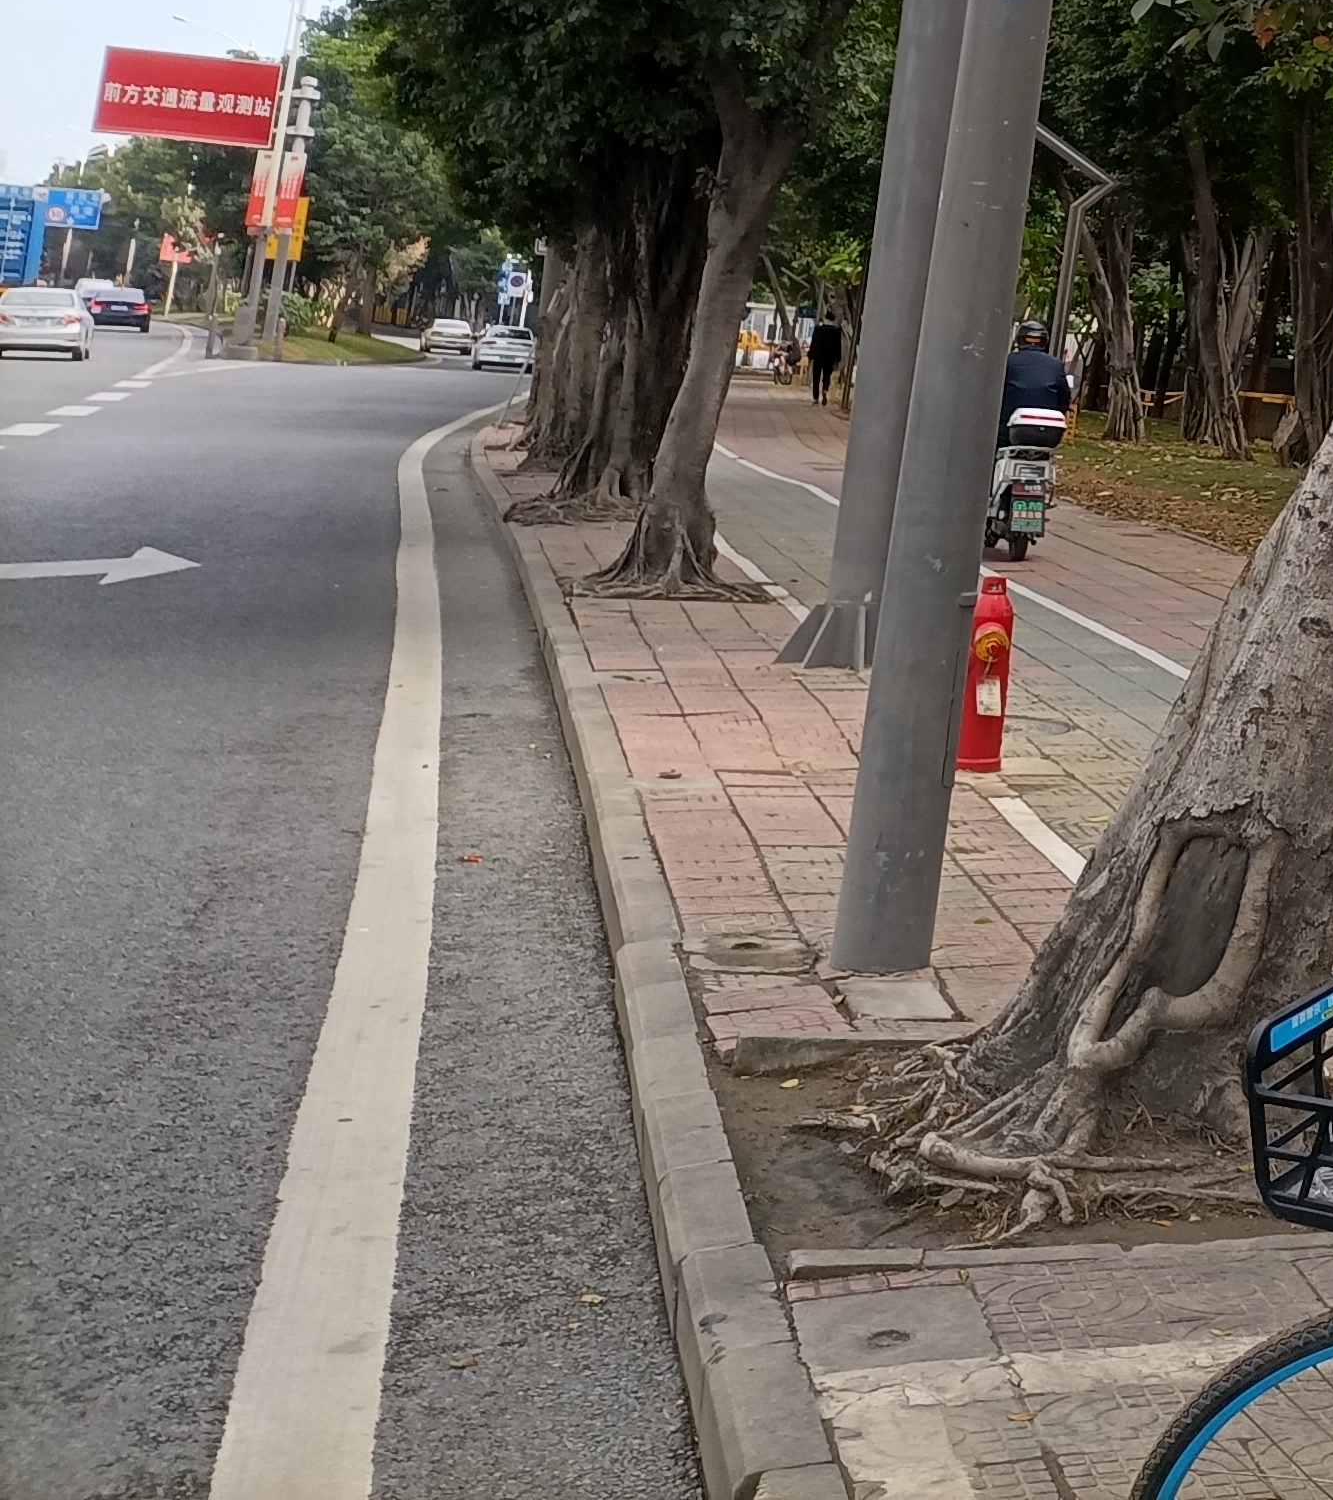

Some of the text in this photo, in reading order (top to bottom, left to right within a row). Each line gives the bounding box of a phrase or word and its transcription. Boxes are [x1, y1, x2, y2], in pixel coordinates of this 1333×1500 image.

[103, 81, 273, 118] 前方交通流量观测站
